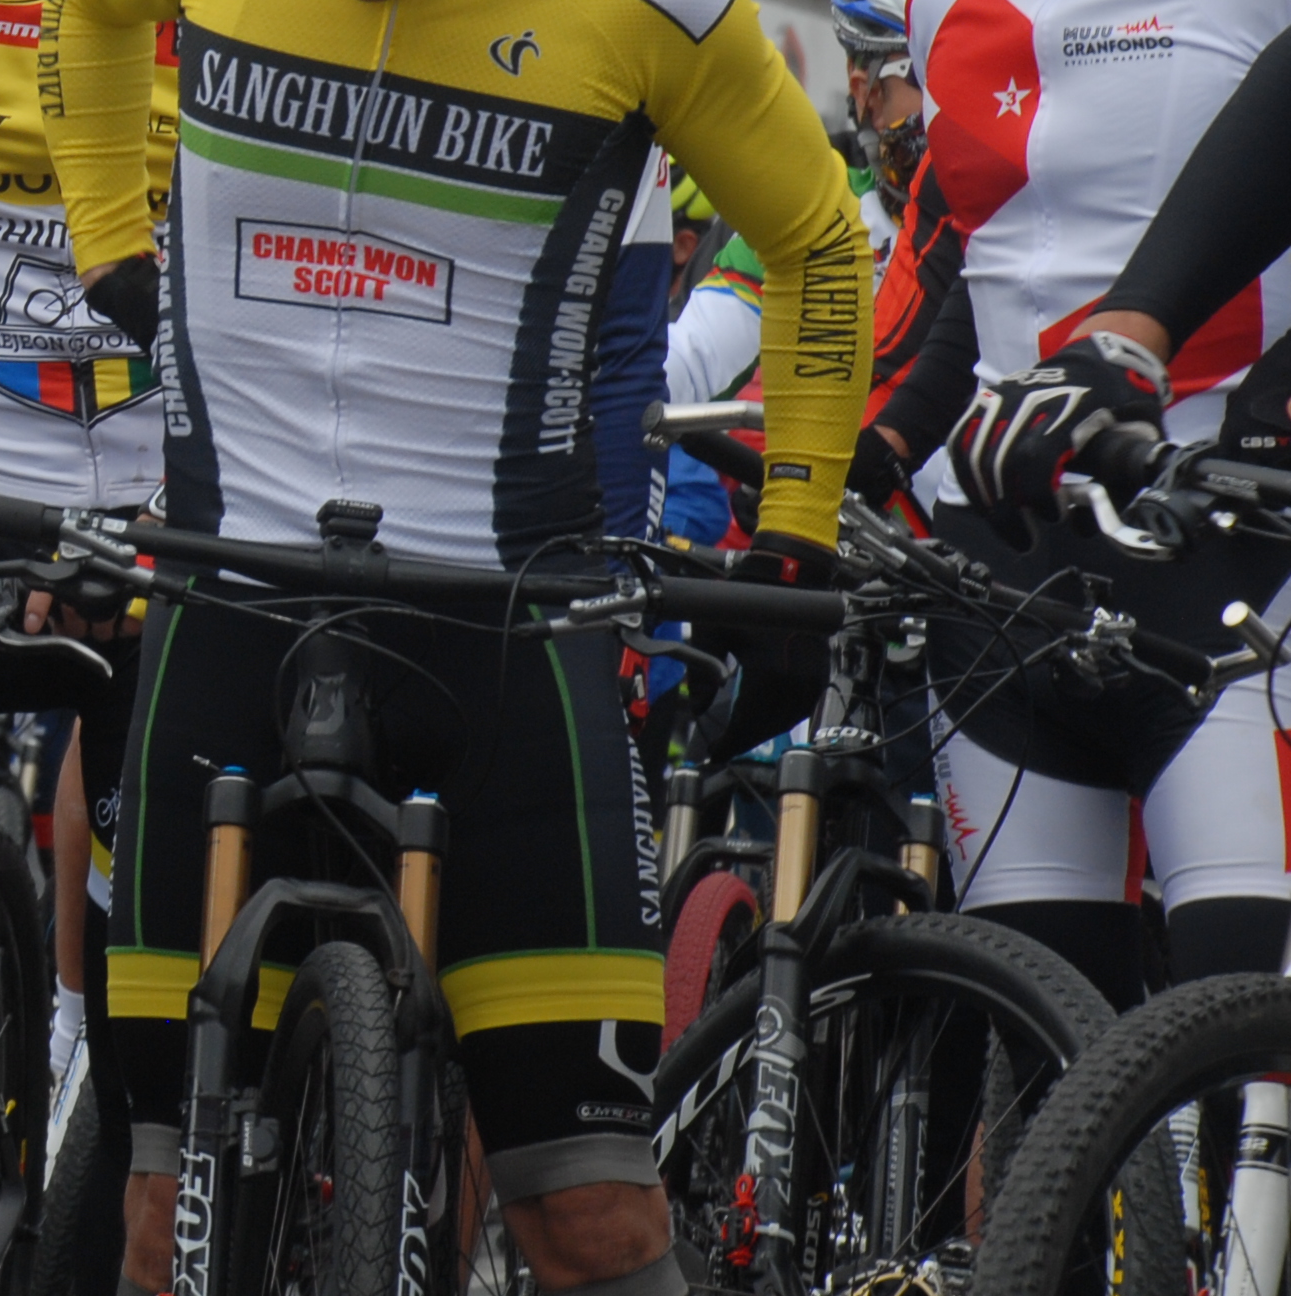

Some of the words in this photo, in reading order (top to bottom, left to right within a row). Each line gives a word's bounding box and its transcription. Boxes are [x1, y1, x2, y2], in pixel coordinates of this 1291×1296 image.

[1063, 25, 1114, 41] MUJU
[1063, 36, 1174, 57] GRANFONDO
[194, 48, 434, 155] SANGHYUN
[433, 102, 554, 179] BIKE
[252, 231, 357, 264] CHANG
[363, 245, 438, 288] WON
[293, 266, 391, 301] SCOTT
